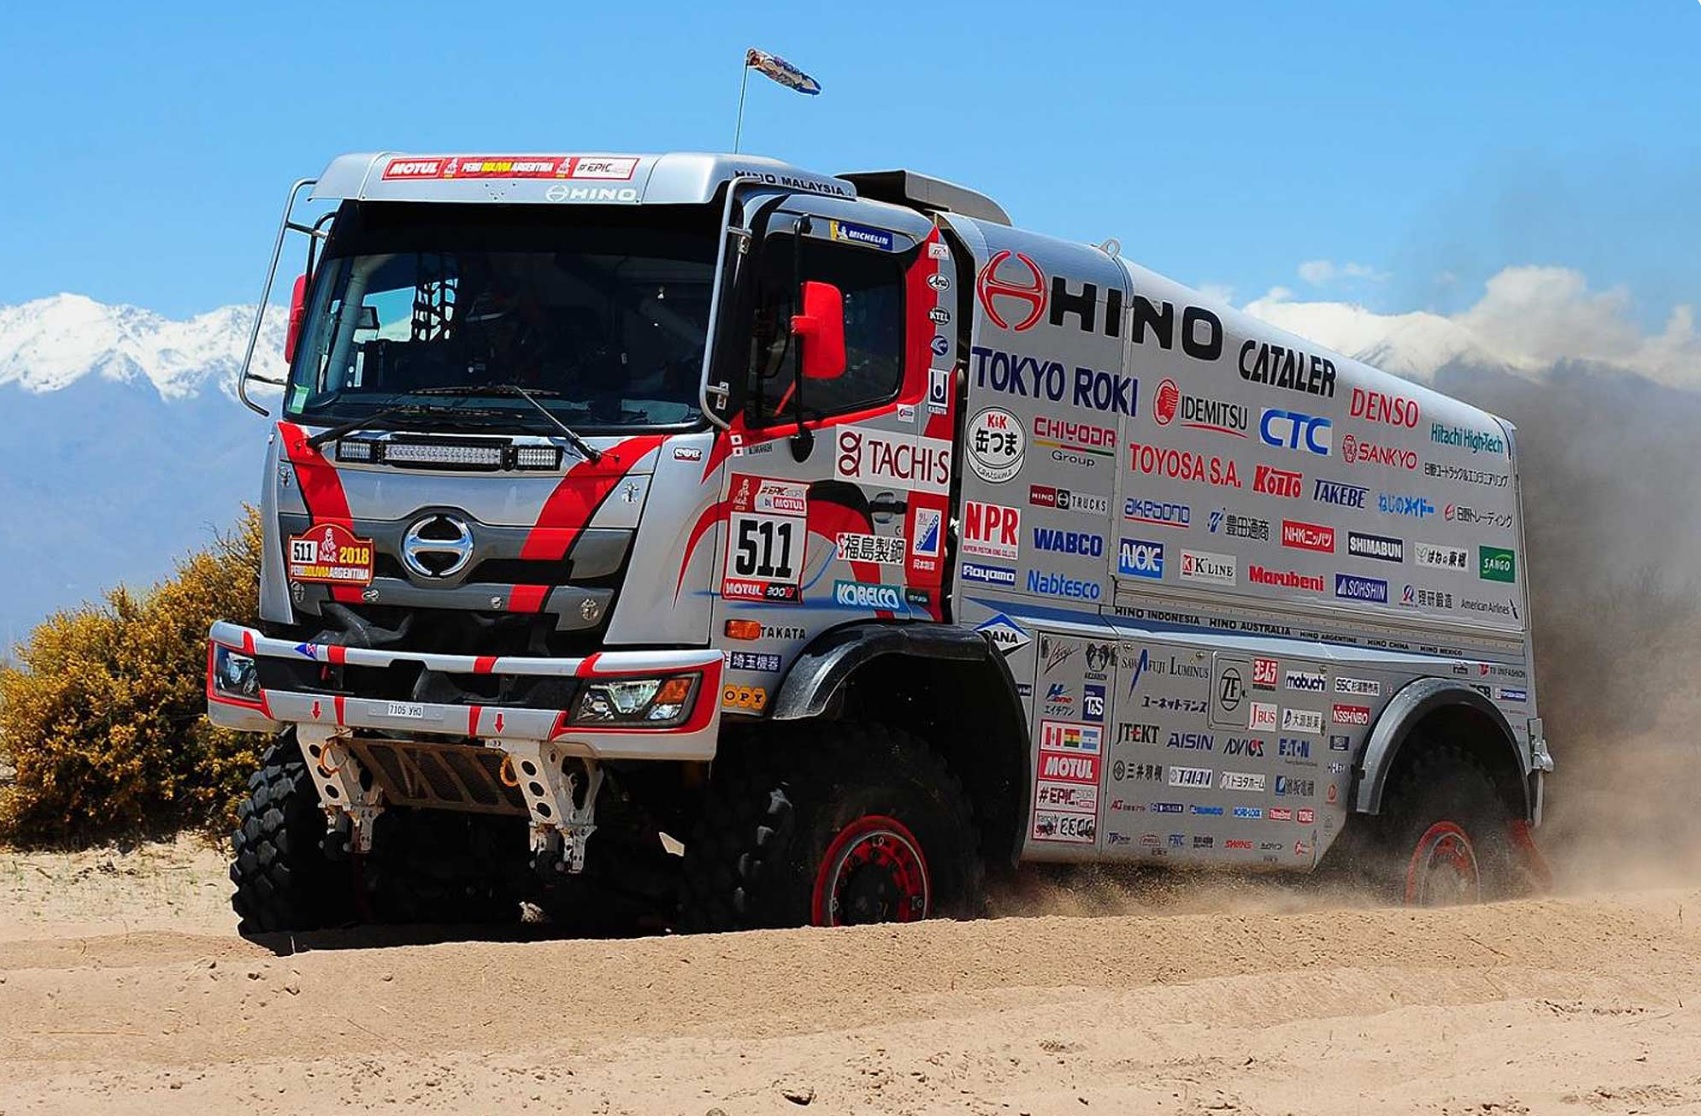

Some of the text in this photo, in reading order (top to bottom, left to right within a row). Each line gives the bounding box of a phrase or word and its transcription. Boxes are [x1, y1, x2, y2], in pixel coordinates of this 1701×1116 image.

[387, 161, 440, 176] MOTUL
[570, 189, 637, 202] HINO
[782, 176, 845, 197] MALAYSIA
[848, 229, 889, 246] MICHELIN
[1049, 276, 1223, 361] HINO
[1238, 338, 1338, 398] CATALER
[971, 346, 1139, 417] TOKYO ROKI
[1181, 394, 1248, 431] IDEMITSU
[1350, 387, 1419, 429] DENSO
[975, 427, 1018, 456] 缶つま
[1033, 416, 1117, 448] CHIYODA
[1260, 408, 1333, 456] CTC
[1430, 423, 1463, 447] Hitachi
[868, 440, 950, 485] TACHI-S
[1051, 449, 1096, 467] Group
[1129, 443, 1242, 488] TOYOSA S.A.
[1358, 443, 1418, 469] SANKYO
[775, 499, 804, 510] MOTUL
[1031, 492, 1054, 501] HINO
[1071, 495, 1107, 512] TRUCKS
[1312, 478, 1371, 509] TAKEBE
[964, 501, 1017, 545] NPR
[1225, 513, 1270, 541] 豊田通商
[294, 543, 312, 561] 511
[735, 519, 792, 579] 511
[1033, 527, 1104, 557] WABCO
[1349, 535, 1402, 559] SHIMABUN
[340, 547, 370, 565] 2018
[1121, 543, 1160, 572] NOK
[1484, 559, 1510, 571] SANGO
[1208, 563, 1234, 577] LINE
[1249, 565, 1324, 592] Marubeni
[726, 582, 763, 596] MOTUL
[837, 583, 900, 609] KOBELCO
[1027, 569, 1100, 600] Nabtesco
[1348, 580, 1386, 600] SOHSHIN
[760, 626, 806, 640] TAKATA
[980, 629, 1019, 644] DANA
[1115, 607, 1144, 618] HINO
[1147, 610, 1201, 625] INDONESIA
[1209, 618, 1237, 630] HINO
[1241, 621, 1291, 636] AUSTRALIA
[1300, 631, 1318, 639] HINO
[1367, 639, 1387, 648] HINO
[1389, 641, 1409, 650] CHINA
[1420, 646, 1438, 654] HINO
[1440, 648, 1462, 657] MEXICO
[1169, 656, 1209, 679] LUMINUS
[1221, 677, 1241, 703] ZF
[1333, 706, 1368, 725] NISSHINBO
[1116, 722, 1160, 745] JTEKT
[1166, 732, 1214, 751] AISIN
[1223, 738, 1264, 757] ADVICS
[1044, 756, 1093, 779] MOTUL
